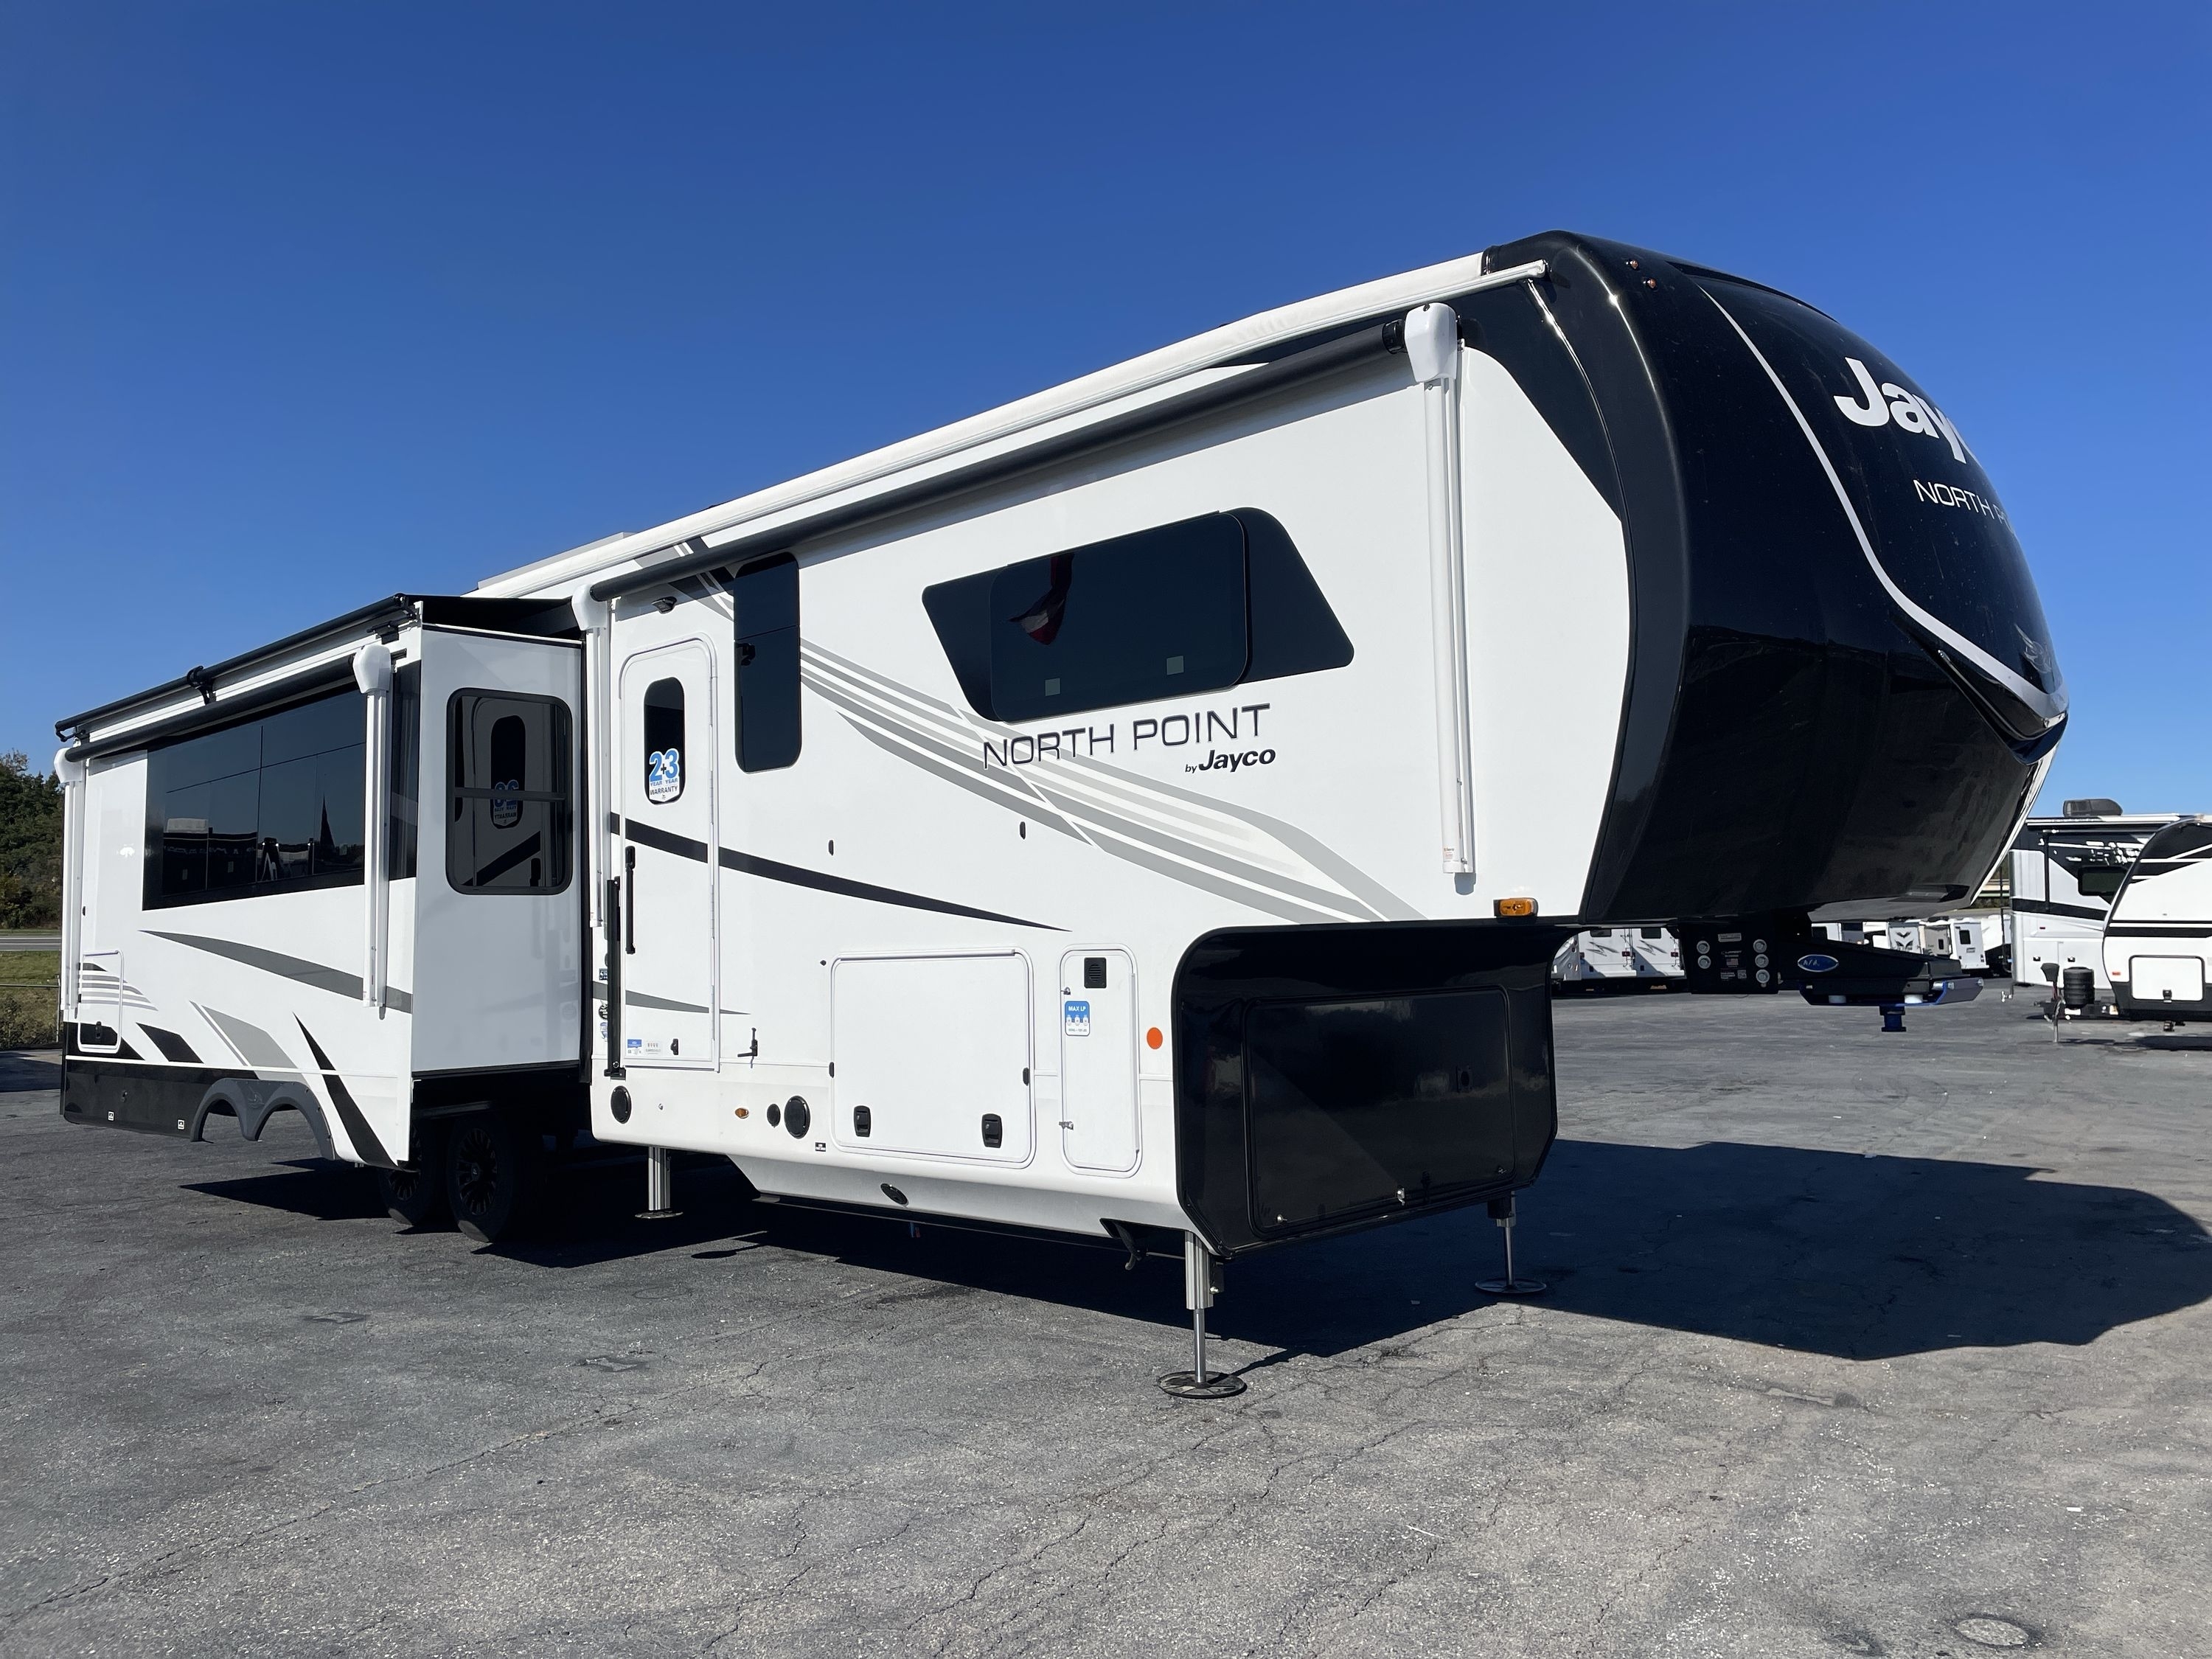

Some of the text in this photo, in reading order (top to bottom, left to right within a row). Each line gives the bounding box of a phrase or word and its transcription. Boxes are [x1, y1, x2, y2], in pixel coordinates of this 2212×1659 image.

[1913, 479, 1995, 520] NORTH
[983, 703, 1270, 770] NORTH POINT
[1185, 748, 1276, 773] by Jayco
[650, 786, 678, 795] WARRANTY
